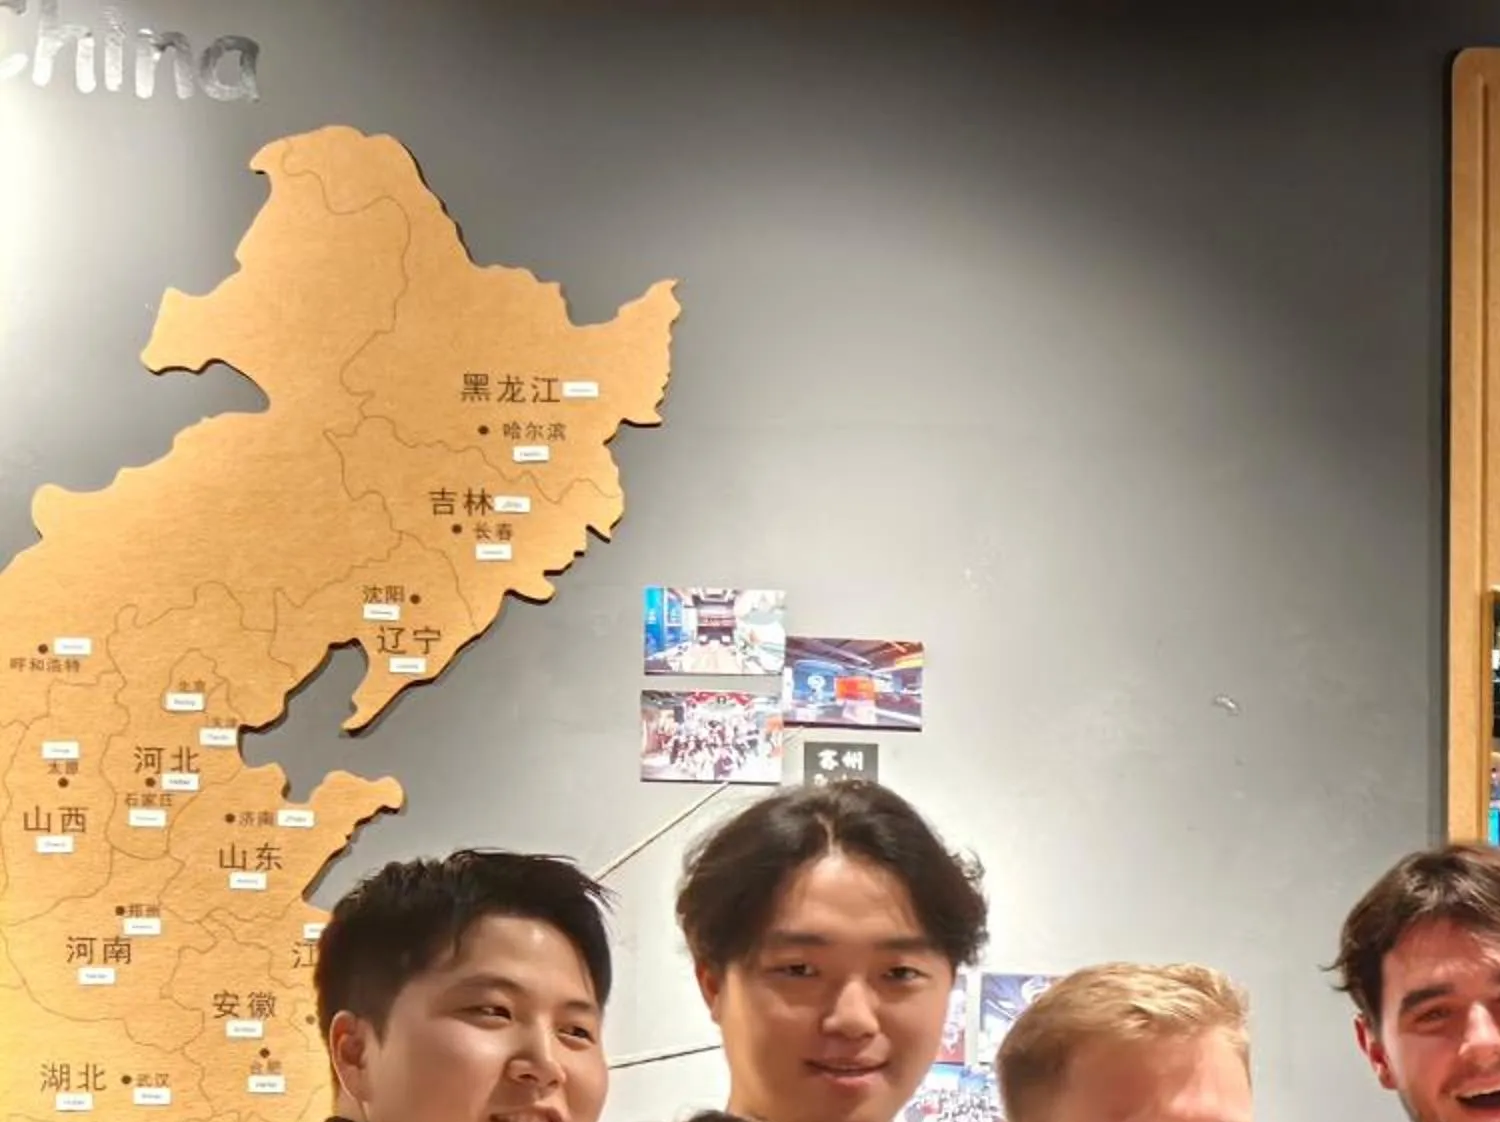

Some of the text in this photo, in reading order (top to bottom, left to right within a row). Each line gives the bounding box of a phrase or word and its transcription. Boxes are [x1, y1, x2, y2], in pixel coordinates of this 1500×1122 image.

[461, 374, 560, 402] 黑龙江
[503, 421, 567, 440] 哈尔滨
[429, 487, 494, 516] 吉林
[473, 521, 512, 541] 长春
[377, 626, 441, 654] 辽宁
[134, 746, 200, 774] 河北
[23, 806, 88, 834] 山西
[219, 842, 282, 871] 山东
[66, 936, 132, 965] 河南
[213, 990, 276, 1018] 安徽
[41, 1062, 107, 1092] 湖北
